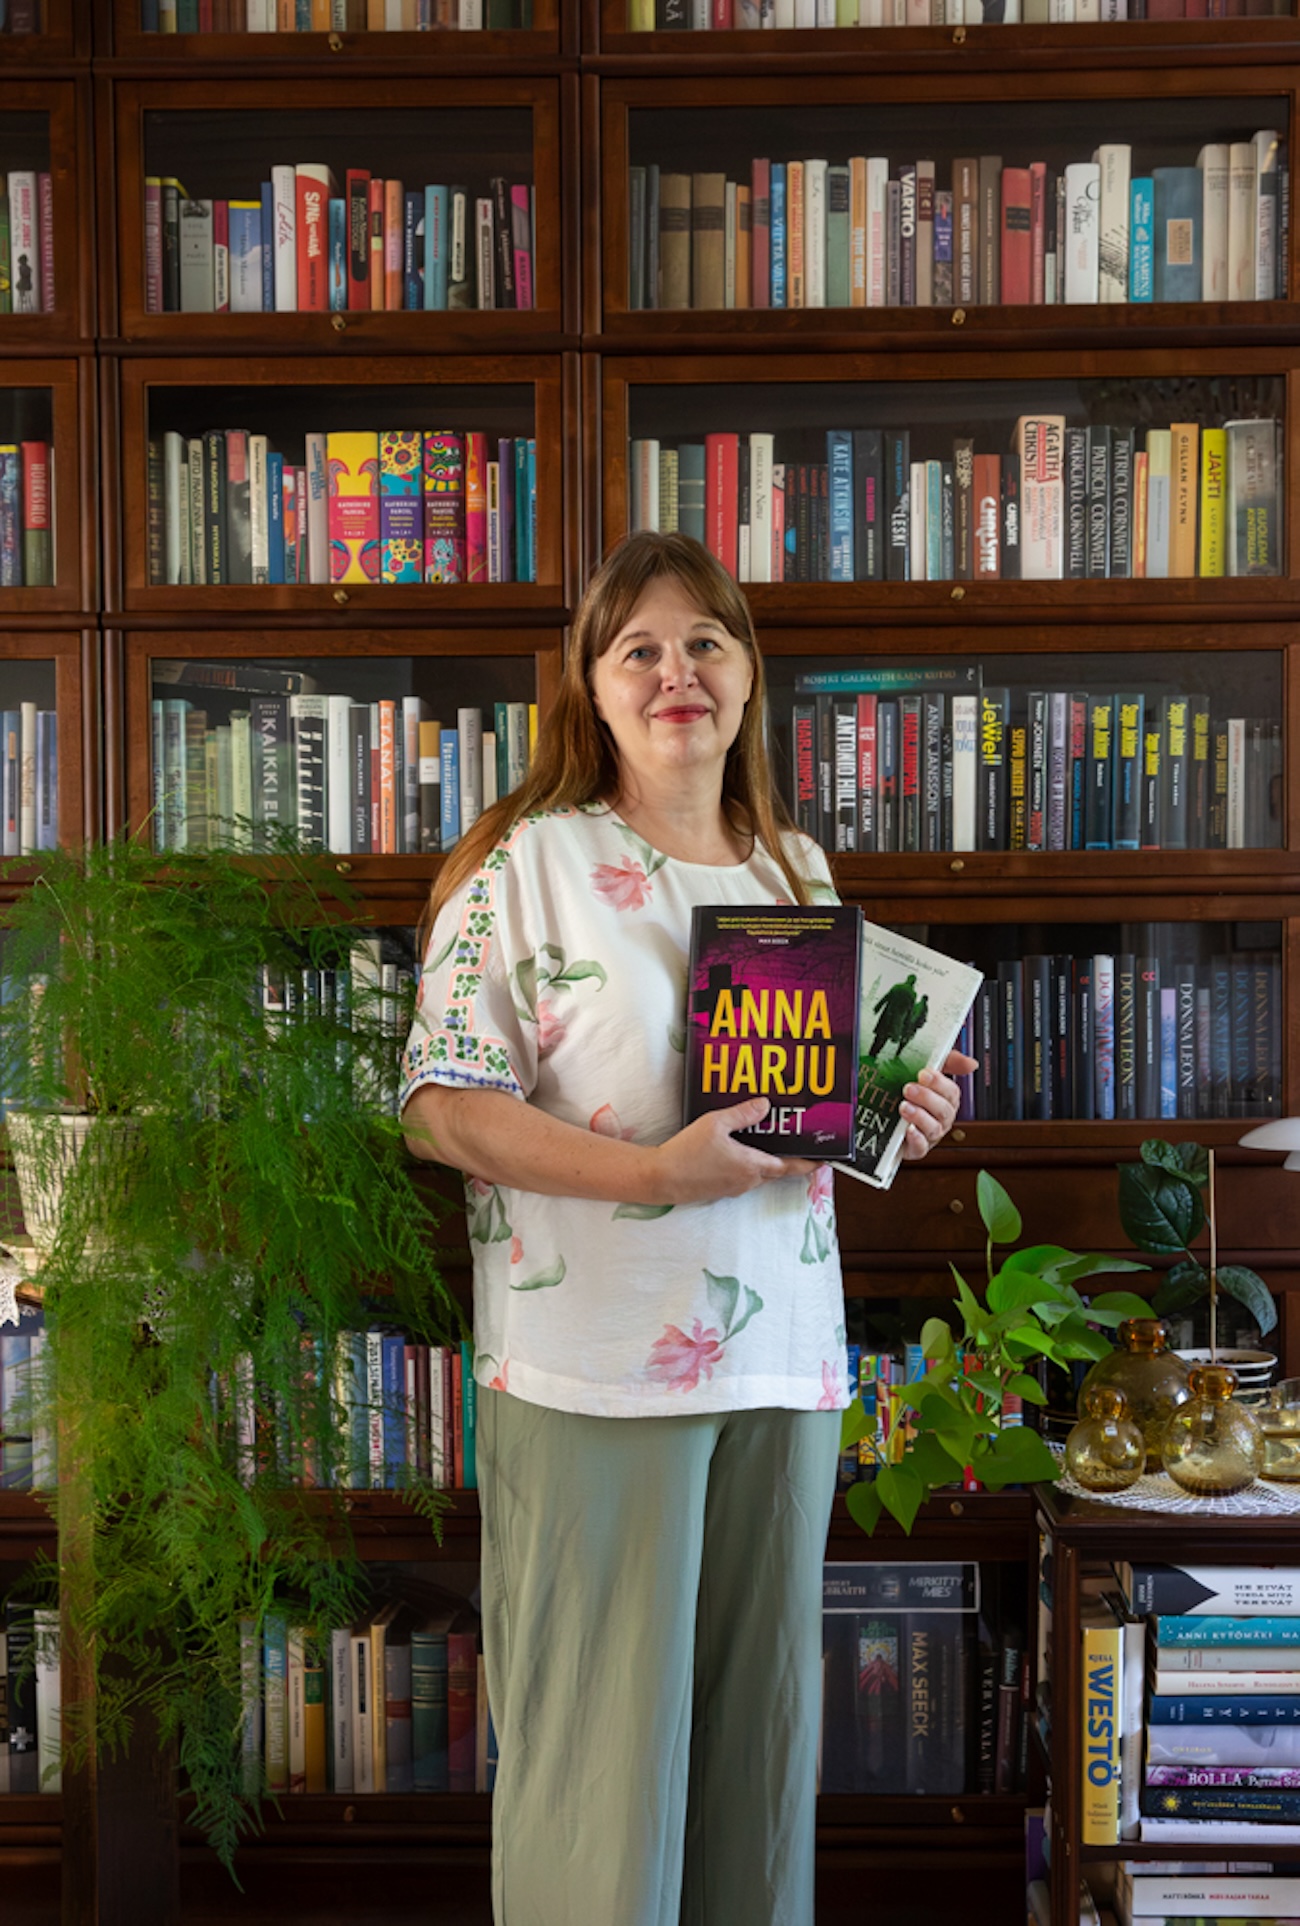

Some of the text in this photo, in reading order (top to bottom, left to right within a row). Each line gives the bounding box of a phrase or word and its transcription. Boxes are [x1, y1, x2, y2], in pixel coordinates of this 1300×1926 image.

[277, 202, 294, 248] Lolita
[901, 172, 916, 238] VARTIO
[833, 444, 851, 534] KATE ATKINSON
[1024, 420, 1040, 482] CHRISTIE
[1039, 423, 1060, 484] AGATHA
[1069, 435, 1085, 487] PATRICIA
[1179, 435, 1190, 525] GILLIAN FLYNN
[1206, 449, 1223, 499] JAHTI
[891, 513, 907, 547] LESKI
[976, 496, 998, 573] CHRISTIE
[1005, 502, 1018, 546] CHRISTIE
[1069, 503, 1085, 571] CORNWELL
[1090, 445, 1107, 573] PATRICIA CORNWELL
[1112, 440, 1129, 567] PATRICIA CORNWELL
[1209, 540, 1217, 575] FOLEY
[262, 717, 278, 794] KAIKKI
[381, 706, 393, 792] ETANAT
[798, 719, 816, 801] HARJUNPÄÄ
[837, 714, 857, 811] ANTONIO HILL
[903, 713, 921, 797] HARJUNPÄÄ
[928, 704, 940, 812] ANNA JANSSON
[1033, 722, 1043, 768] JOKINEN
[862, 751, 873, 833] KUOLLUT KULMA
[709, 988, 832, 1040] ANNA
[1099, 972, 1113, 1084] DONNA LEON
[1120, 972, 1134, 1084] DONNA LEON
[1180, 983, 1194, 1088] DONNA LEON
[1214, 971, 1229, 1084] DONNA LEON
[1235, 971, 1250, 1083] DONNA LEON
[1254, 971, 1269, 1084] DONNA LEON
[701, 1043, 836, 1097] HARJU
[909, 1576, 964, 1588] MERKITTY
[921, 1586, 952, 1598] MIES
[1176, 1630, 1273, 1640] ANNI KYTÖMÄKI
[911, 1631, 929, 1738] MAX SEECK
[981, 1667, 994, 1711] VERA
[1088, 1663, 1120, 1787] WESTÖ
[1188, 1773, 1243, 1786] BOLLA
